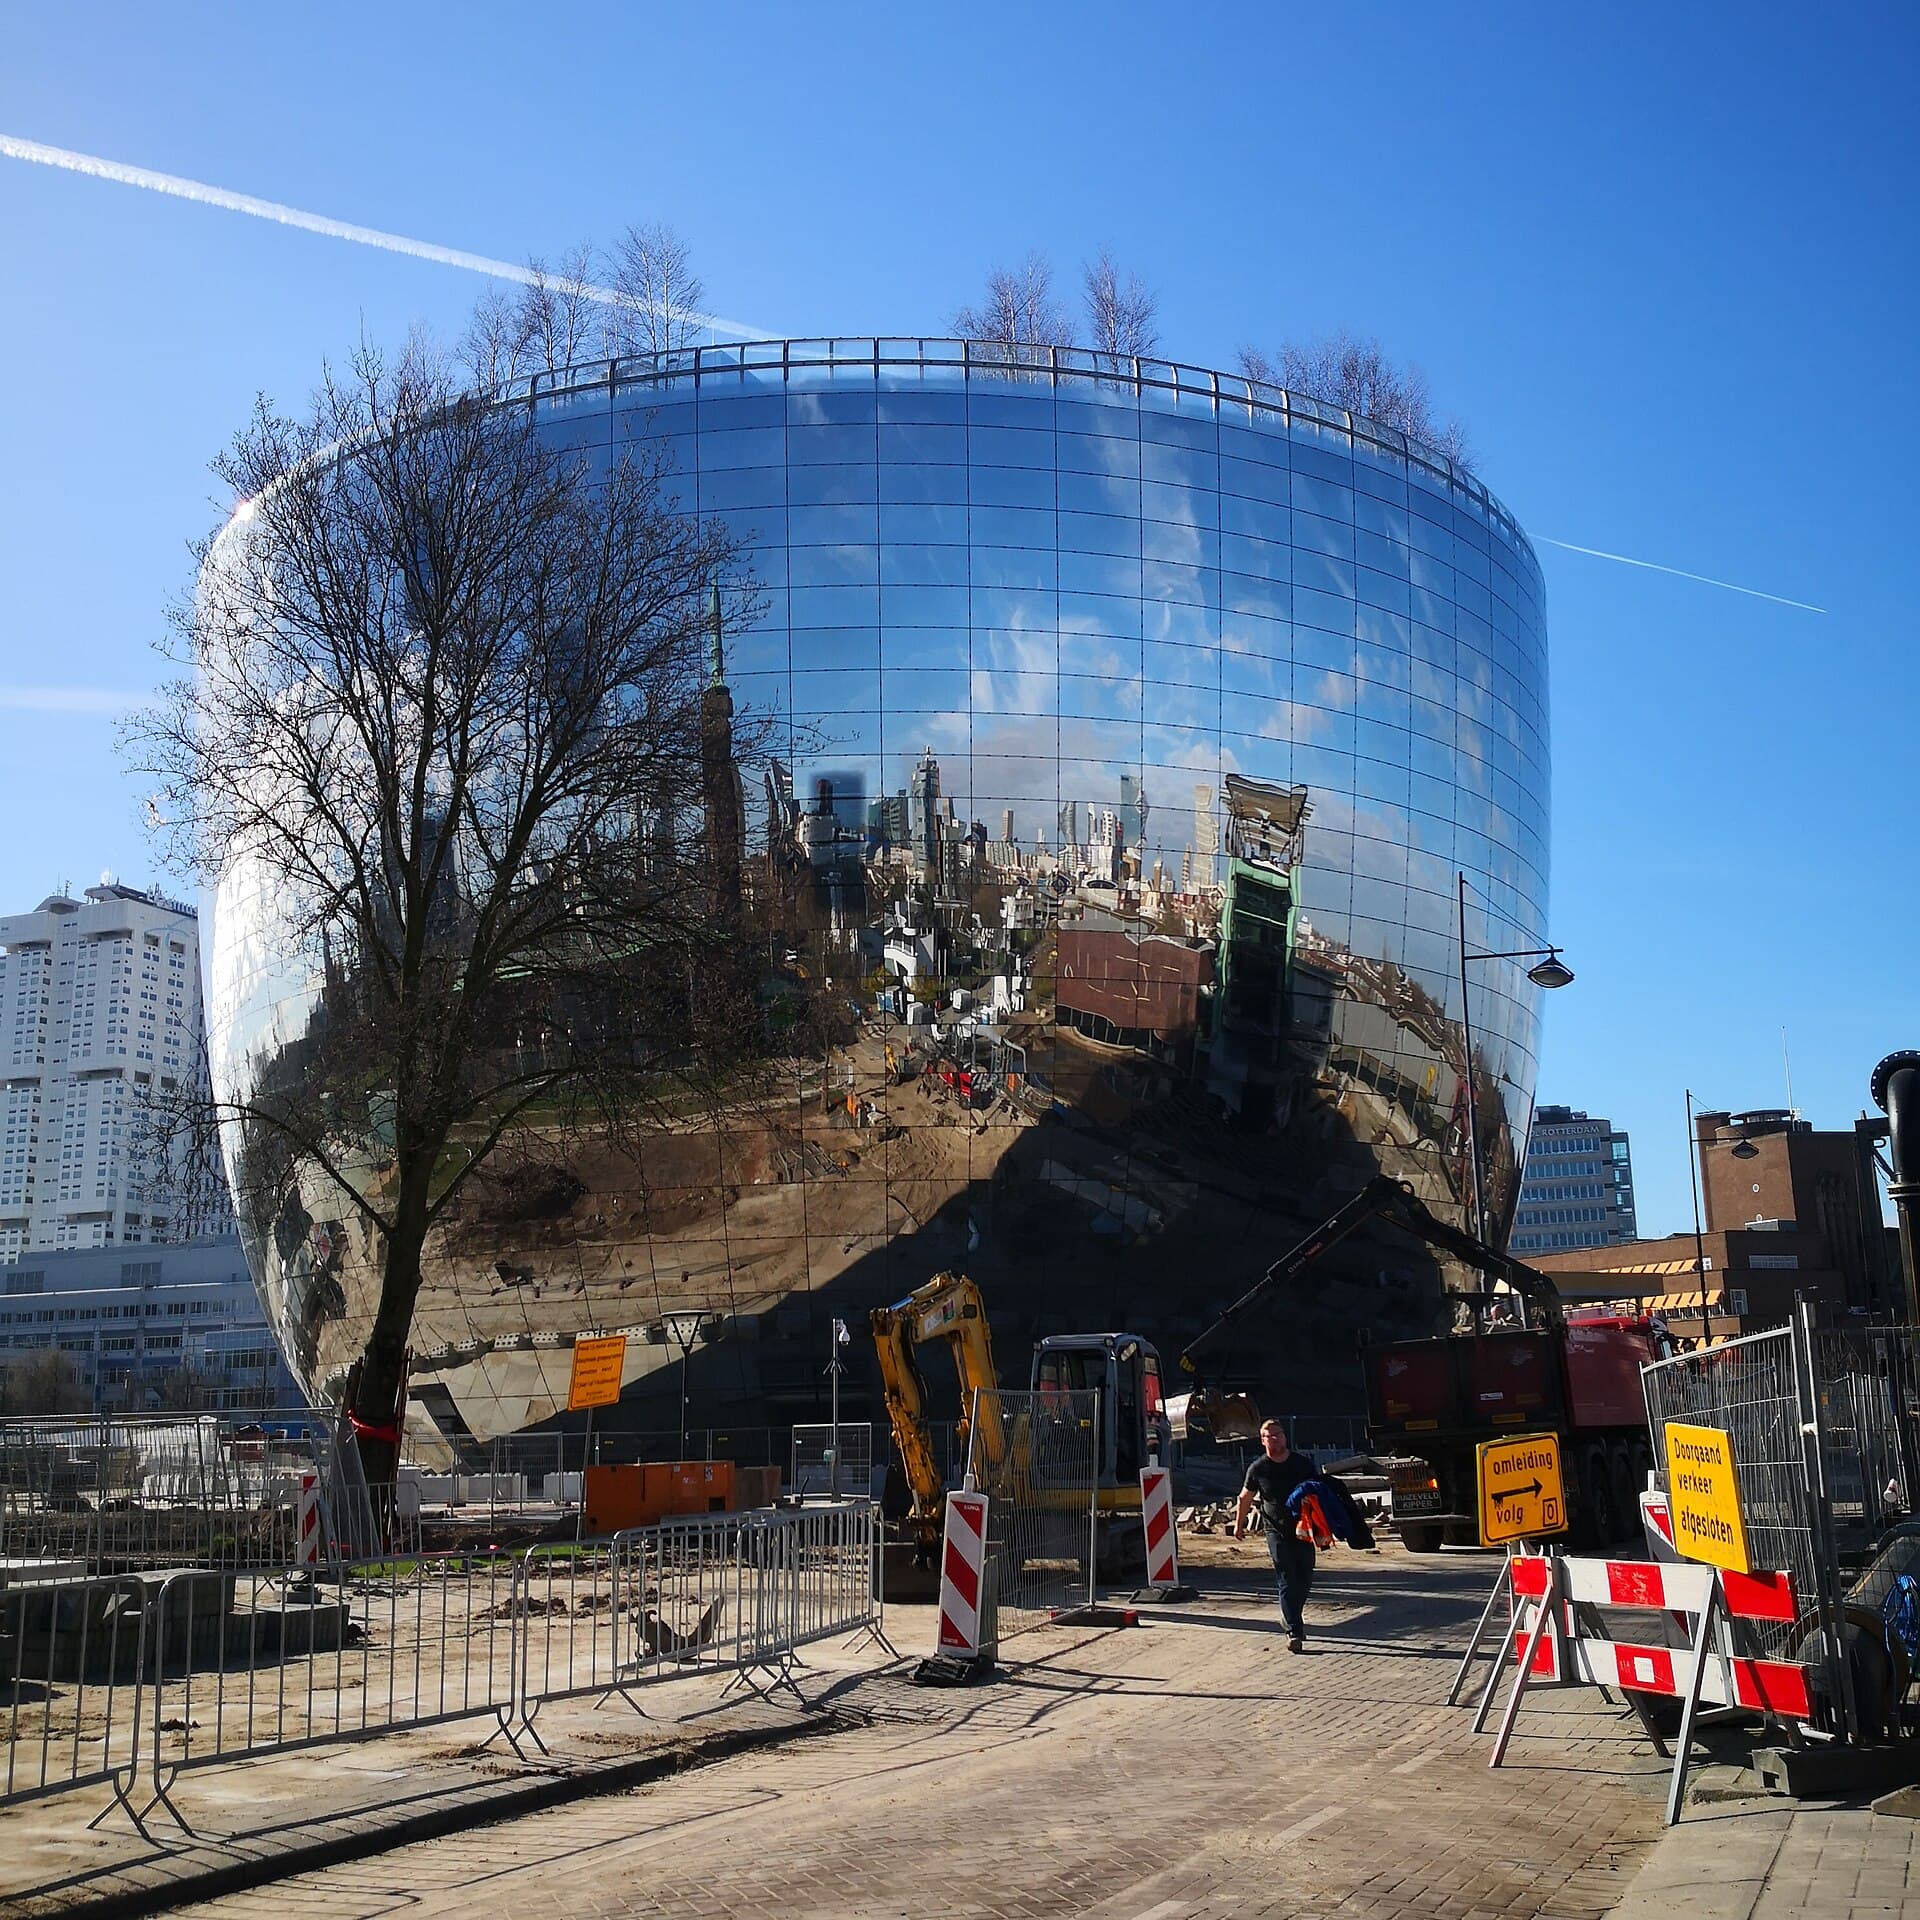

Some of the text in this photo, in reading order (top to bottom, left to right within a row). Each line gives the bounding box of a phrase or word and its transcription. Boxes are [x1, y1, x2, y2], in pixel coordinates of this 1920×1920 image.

[1542, 1126, 1600, 1136] ROTTERDAM
[1493, 1450, 1553, 1475] omleiding
[1674, 1437, 1722, 1468] Doorgaand
[1678, 1471, 1713, 1494] verkeer
[1496, 1503, 1524, 1525] volg
[1681, 1505, 1734, 1545] afgesloten
